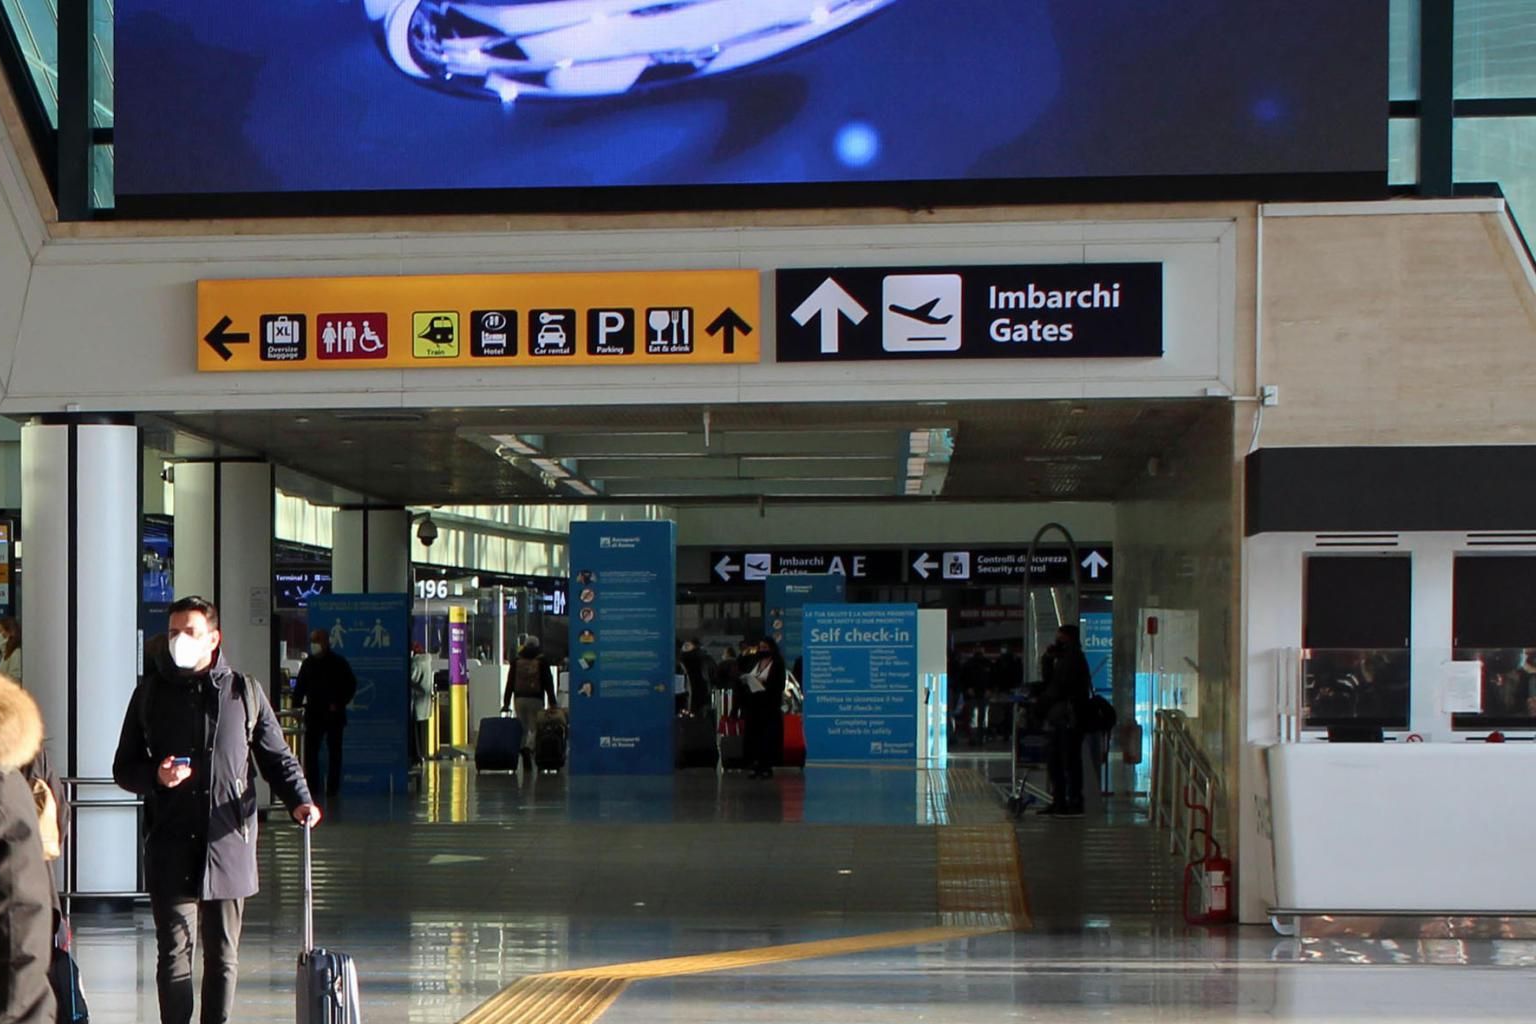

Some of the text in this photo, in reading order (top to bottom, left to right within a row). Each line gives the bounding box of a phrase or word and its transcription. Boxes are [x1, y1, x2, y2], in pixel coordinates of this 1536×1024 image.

[988, 282, 1120, 311] Imbarchi
[275, 326, 291, 337] XL
[988, 317, 1074, 343] Gates
[548, 347, 570, 355] rental
[596, 346, 624, 354] Parking
[977, 555, 1015, 564] Controlli
[1030, 555, 1068, 563] icurezza
[779, 556, 867, 577] Imbarchi A E
[977, 565, 1047, 575] Security cotrol
[417, 579, 448, 599] 196
[810, 627, 909, 642] Self check-in
